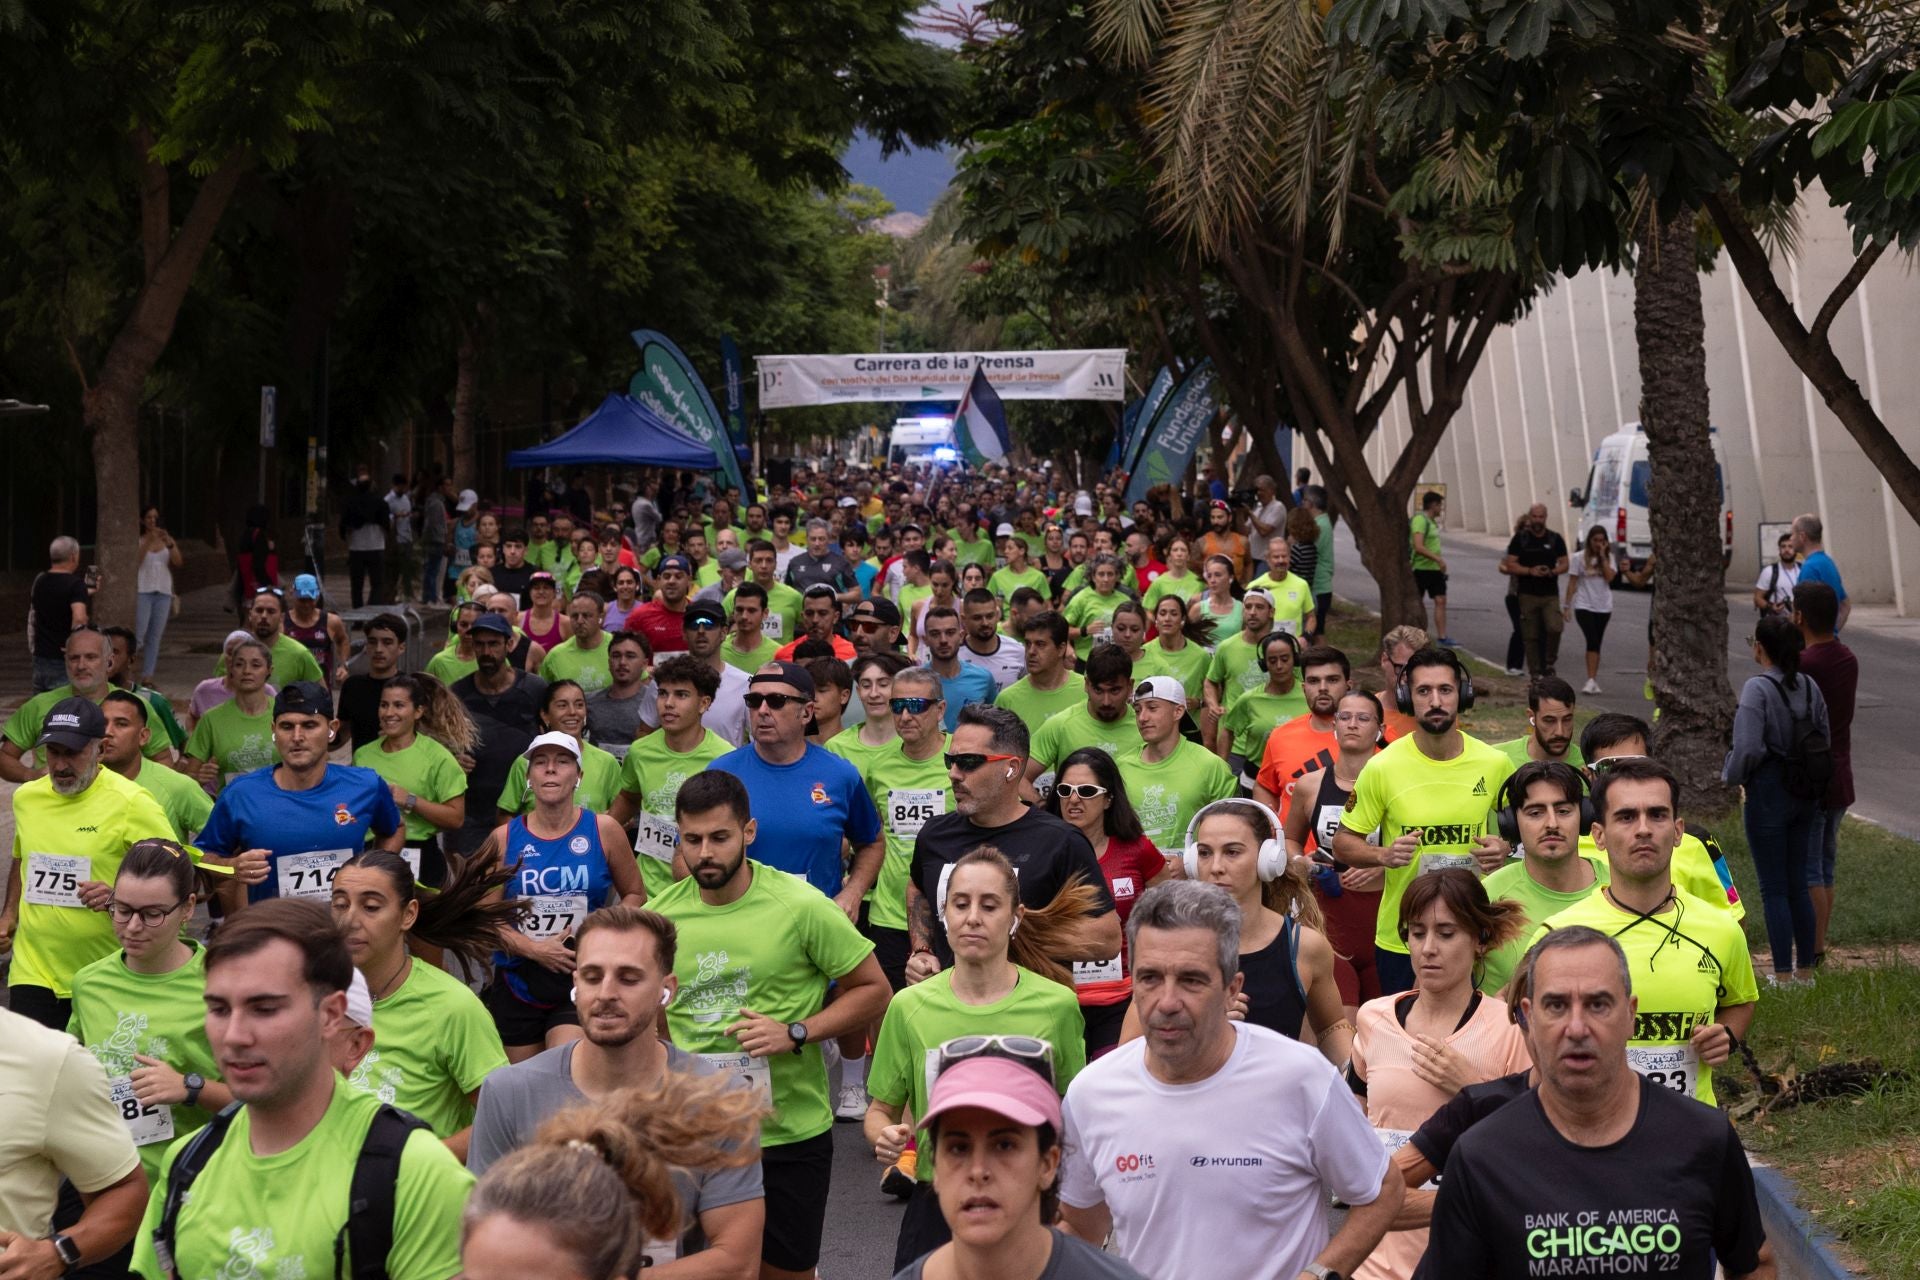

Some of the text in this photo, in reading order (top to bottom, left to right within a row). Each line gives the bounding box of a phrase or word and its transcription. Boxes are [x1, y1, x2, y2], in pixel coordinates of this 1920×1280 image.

[854, 355, 1035, 371] Carrera de la Prensa
[911, 371, 948, 382] Mundial
[1171, 396, 1212, 454] Unicaja
[895, 805, 934, 821] 845
[643, 827, 677, 848] 112
[34, 870, 77, 891] 775
[522, 865, 589, 894] RCM
[1115, 887, 1130, 895] AXA
[526, 913, 574, 931] 377
[1212, 1158, 1262, 1166] HYUNDAI
[1525, 1209, 1679, 1229] BANK OF AMERICA
[1527, 1224, 1681, 1258] CHICAGO
[1529, 1255, 1648, 1277] MARATHON
